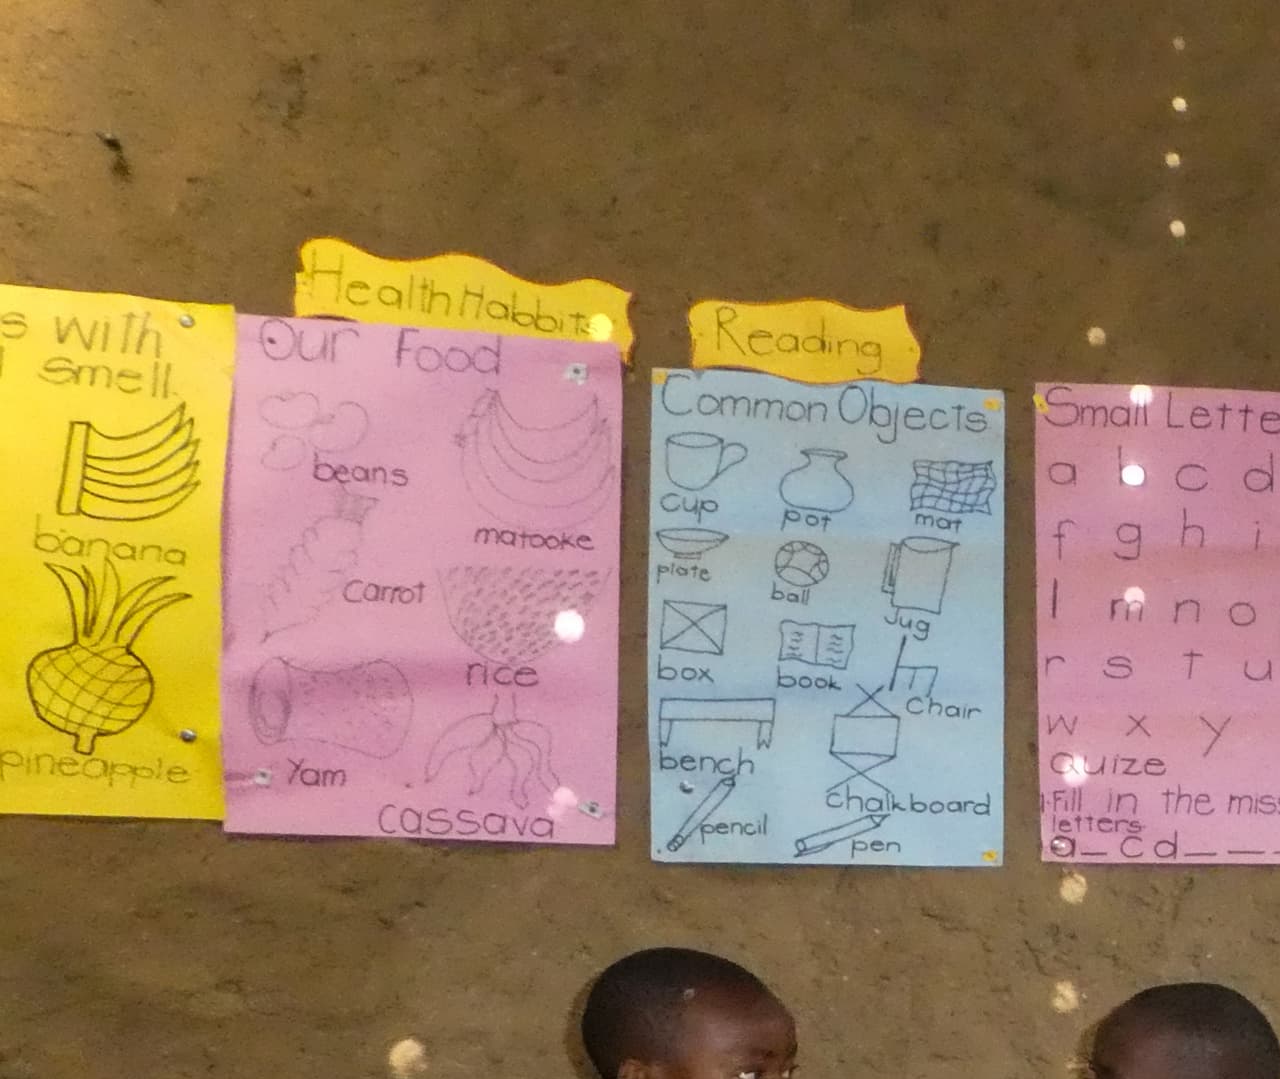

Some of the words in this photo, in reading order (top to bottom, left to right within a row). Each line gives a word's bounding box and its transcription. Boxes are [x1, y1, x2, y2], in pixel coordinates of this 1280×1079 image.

[303, 254, 452, 317] Health
[55, 311, 161, 358] with
[260, 318, 360, 362] Our
[394, 325, 502, 377] Food
[715, 306, 882, 376] Reading
[38, 356, 172, 399] smell
[661, 374, 828, 422] Common
[838, 384, 988, 444] Objects
[1044, 385, 1149, 428] Small
[312, 453, 410, 489] beans
[1049, 462, 1078, 486] a
[1243, 452, 1275, 493] d
[780, 509, 832, 531] pot
[914, 512, 962, 534] mat
[1052, 519, 1077, 560] f
[1113, 522, 1142, 561] g
[1180, 508, 1205, 548] h
[33, 513, 187, 566] banana
[473, 524, 596, 552] matooke
[656, 562, 711, 583] plate
[771, 582, 811, 605] ball
[1172, 598, 1201, 624] n
[1228, 602, 1256, 626] o
[465, 660, 540, 688] rice
[656, 654, 714, 682] box
[777, 664, 842, 691] book
[1044, 655, 1066, 677] r
[1102, 655, 1134, 680] s
[1183, 650, 1203, 680] t
[1243, 659, 1272, 681] u
[1199, 716, 1232, 757] y
[0, 750, 191, 789] pineapple
[286, 758, 347, 788] Yam
[659, 747, 755, 775] bench
[1106, 791, 1138, 815] in
[1161, 784, 1215, 815] the
[699, 813, 768, 844] pencil
[851, 839, 901, 858] pen
